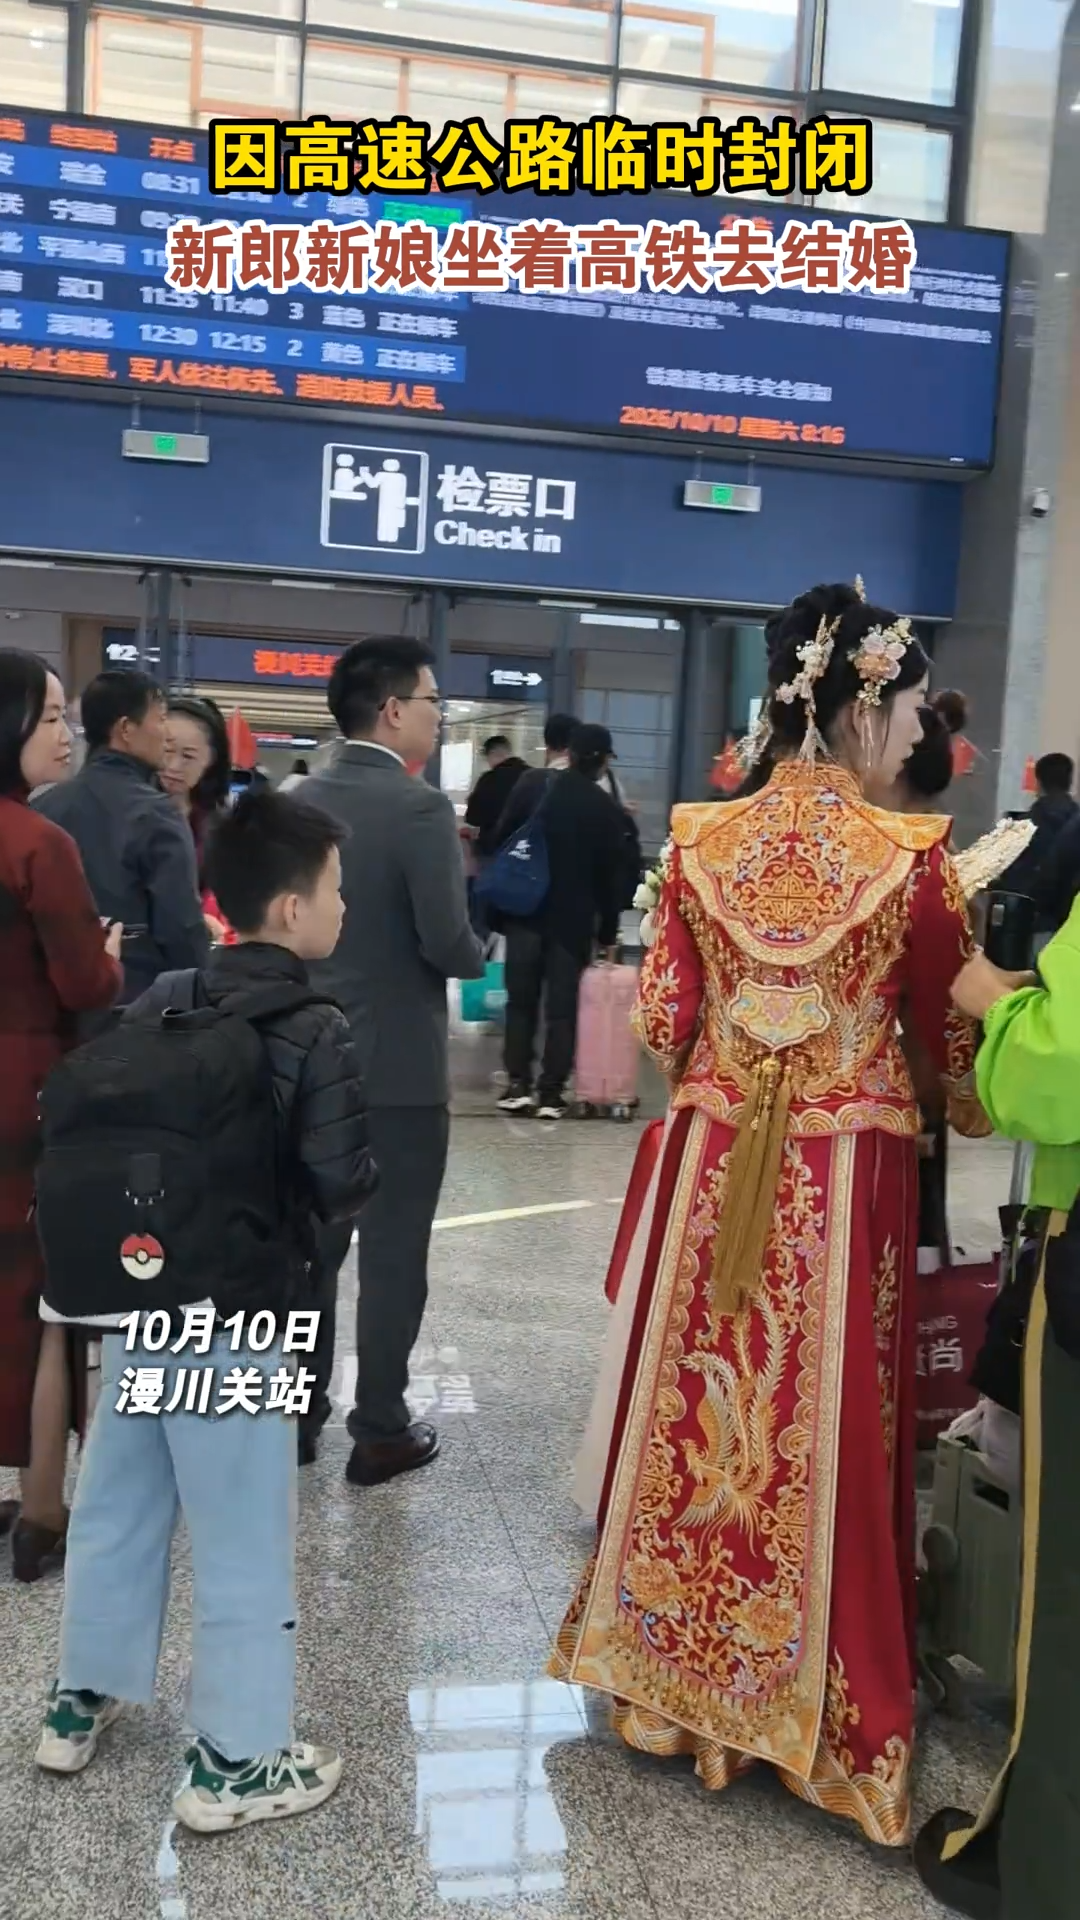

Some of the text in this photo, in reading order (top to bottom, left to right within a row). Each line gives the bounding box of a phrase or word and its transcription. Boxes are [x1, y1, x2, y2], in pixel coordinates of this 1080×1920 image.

[288, 302, 304, 320] 3
[209, 331, 267, 353] 12:15
[286, 339, 303, 357] 2
[436, 464, 577, 520] 检票口
[434, 519, 562, 553] Check in
